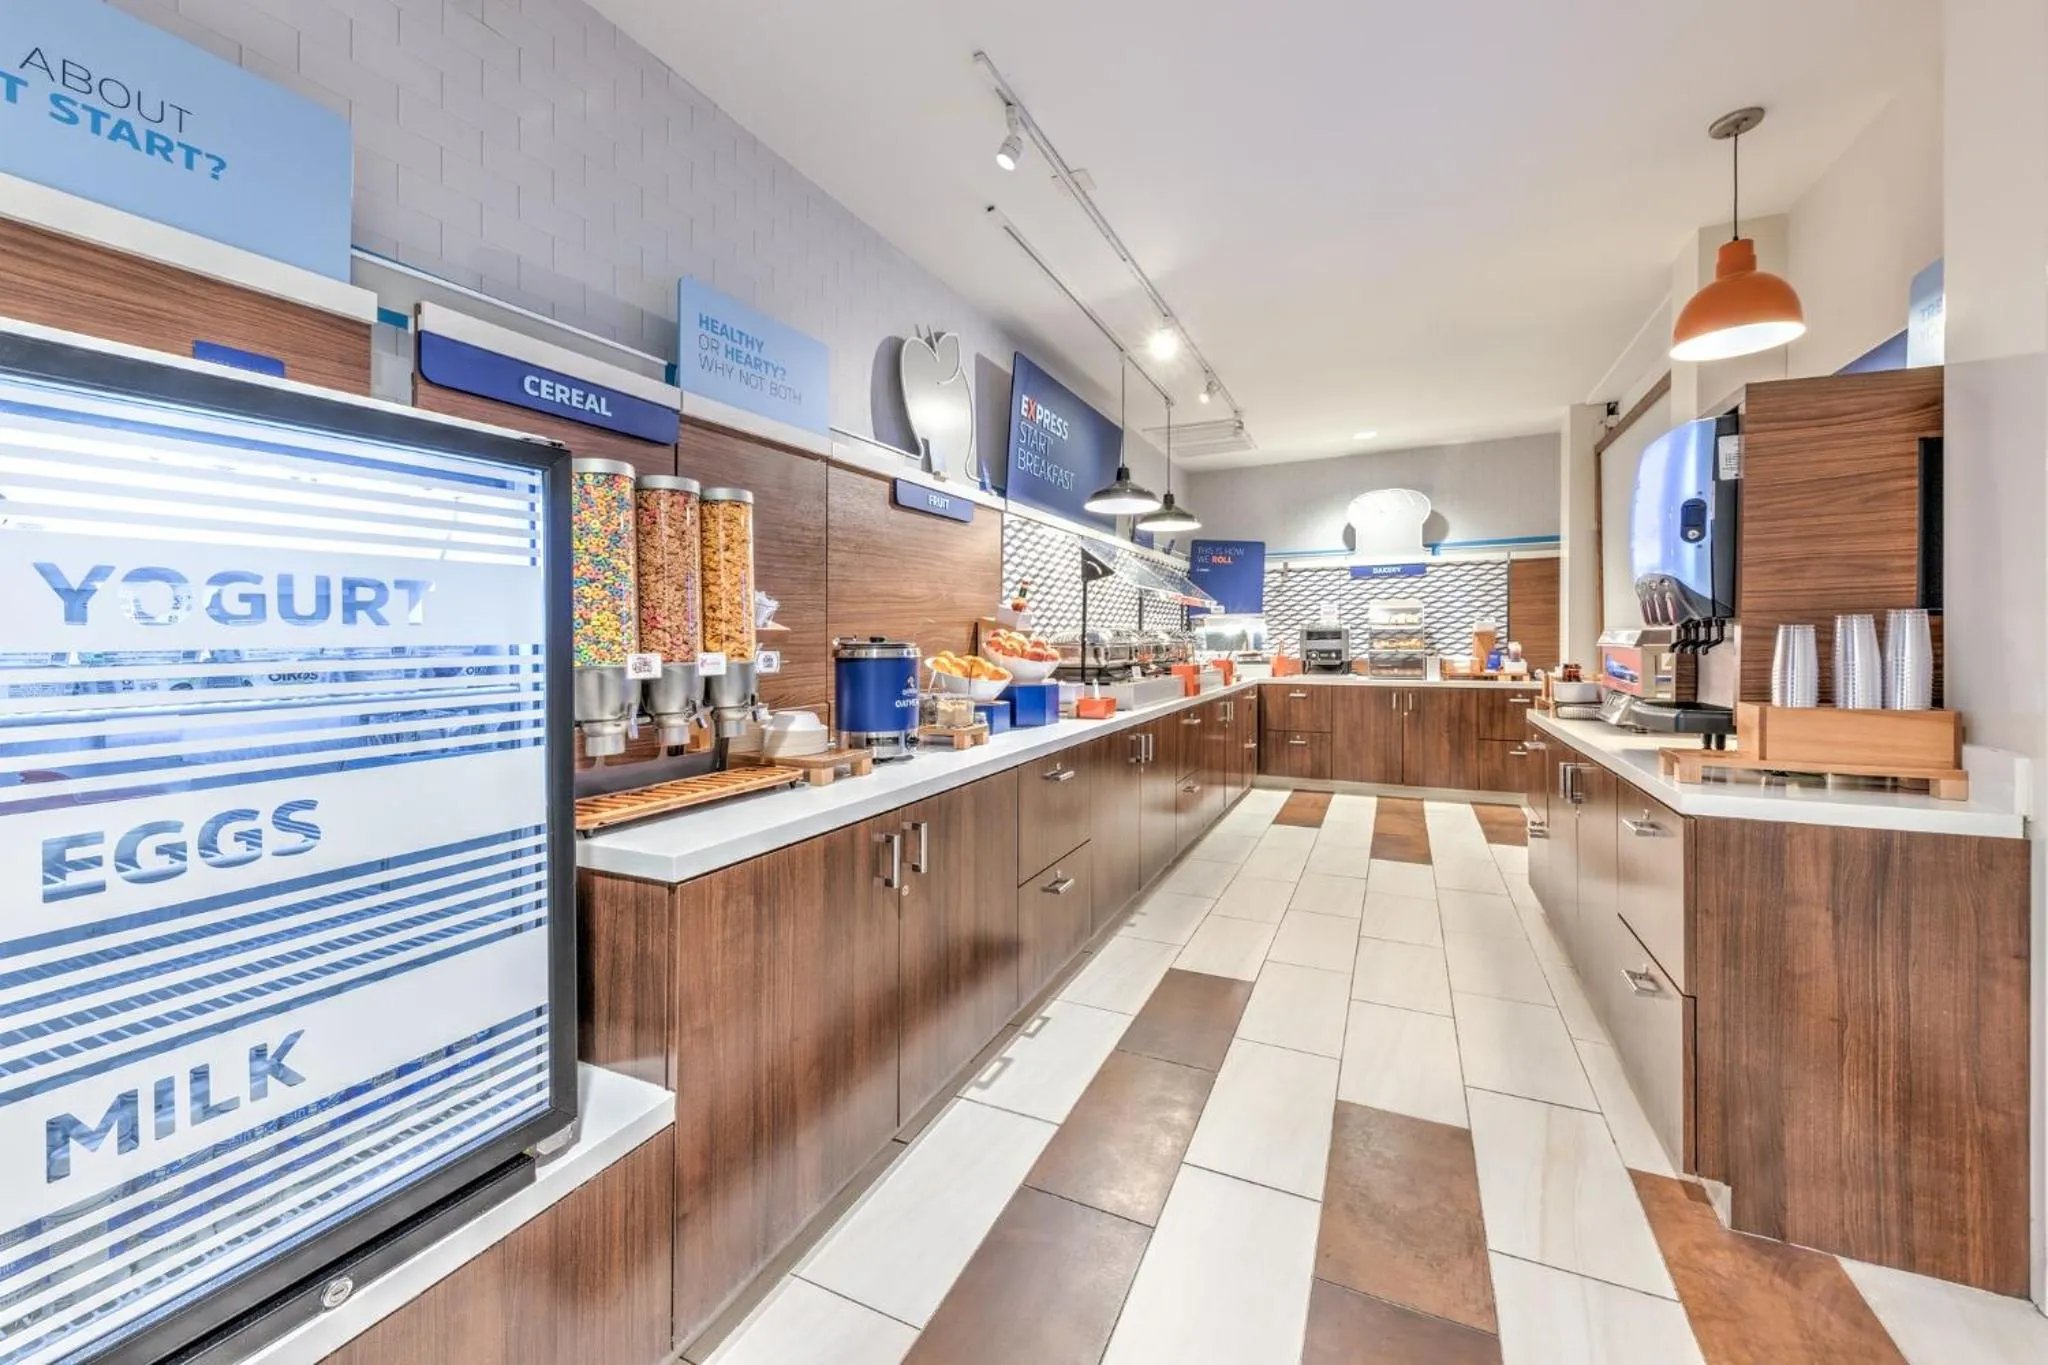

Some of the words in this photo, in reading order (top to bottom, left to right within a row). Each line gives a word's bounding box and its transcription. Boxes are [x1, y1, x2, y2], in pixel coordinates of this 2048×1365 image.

[19, 47, 193, 133] ABOUT
[48, 92, 227, 181] START?
[698, 313, 765, 354] HEALTHY
[698, 334, 720, 355] OR
[724, 344, 787, 381] HEARTY?
[698, 353, 735, 378] WHY
[739, 369, 765, 391] NOT
[769, 381, 802, 405] BOTH
[523, 375, 612, 417] CEREAL
[1020, 394, 1069, 440] EXPRESS
[1018, 420, 1052, 456] START
[1017, 448, 1075, 492] BREAKFAST
[928, 494, 950, 510] FRUIT
[1211, 555, 1233, 565] ROLL
[33, 562, 436, 626] YOGURT
[42, 799, 322, 904] EGGS
[46, 1030, 307, 1184] MILK
